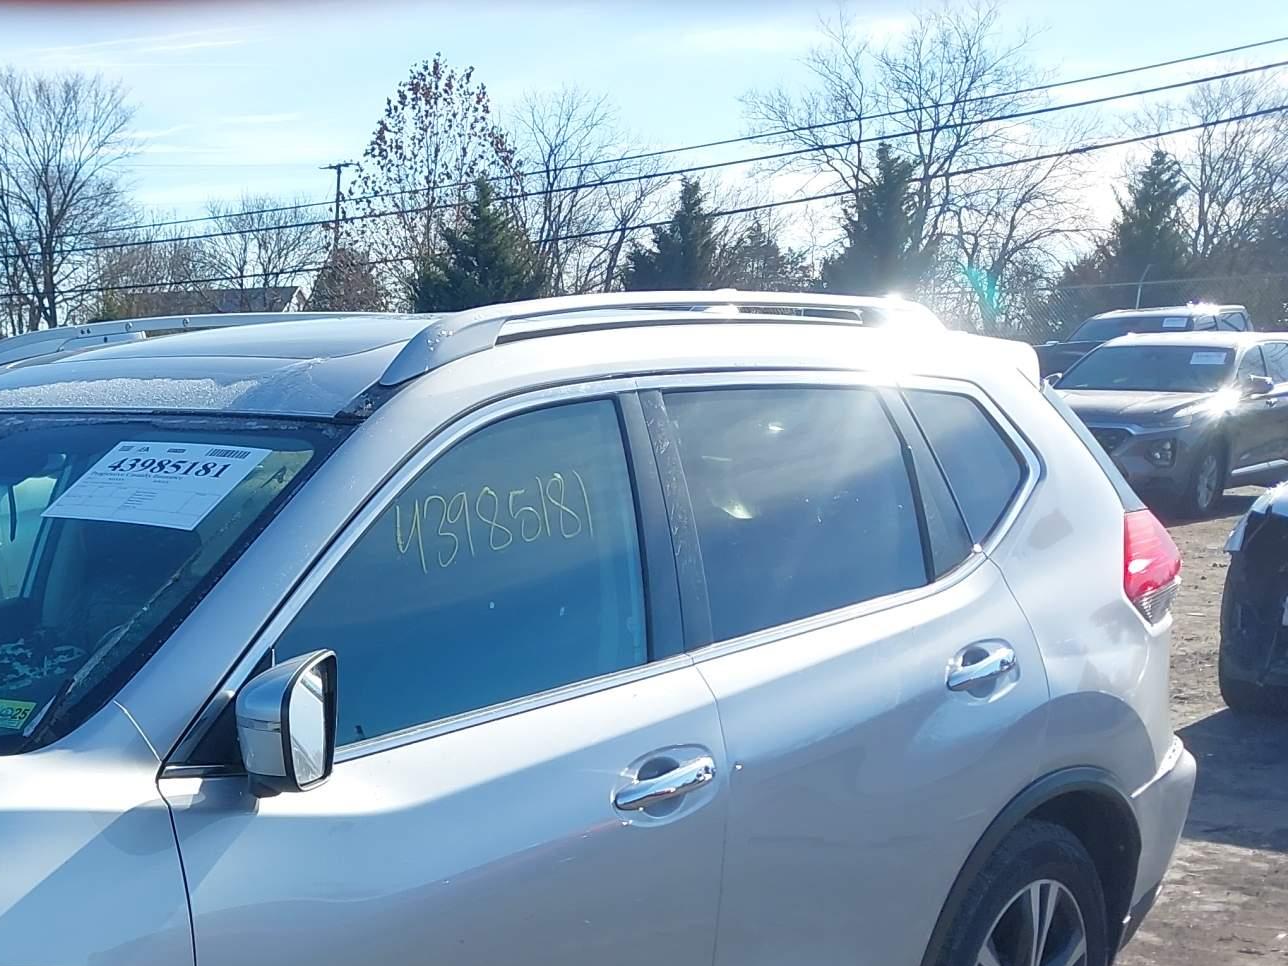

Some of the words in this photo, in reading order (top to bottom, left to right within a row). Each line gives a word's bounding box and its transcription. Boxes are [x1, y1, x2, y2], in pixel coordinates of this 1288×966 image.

[107, 457, 232, 479] 43985181
[395, 469, 594, 575] 43985181
[11, 707, 31, 720] 25
